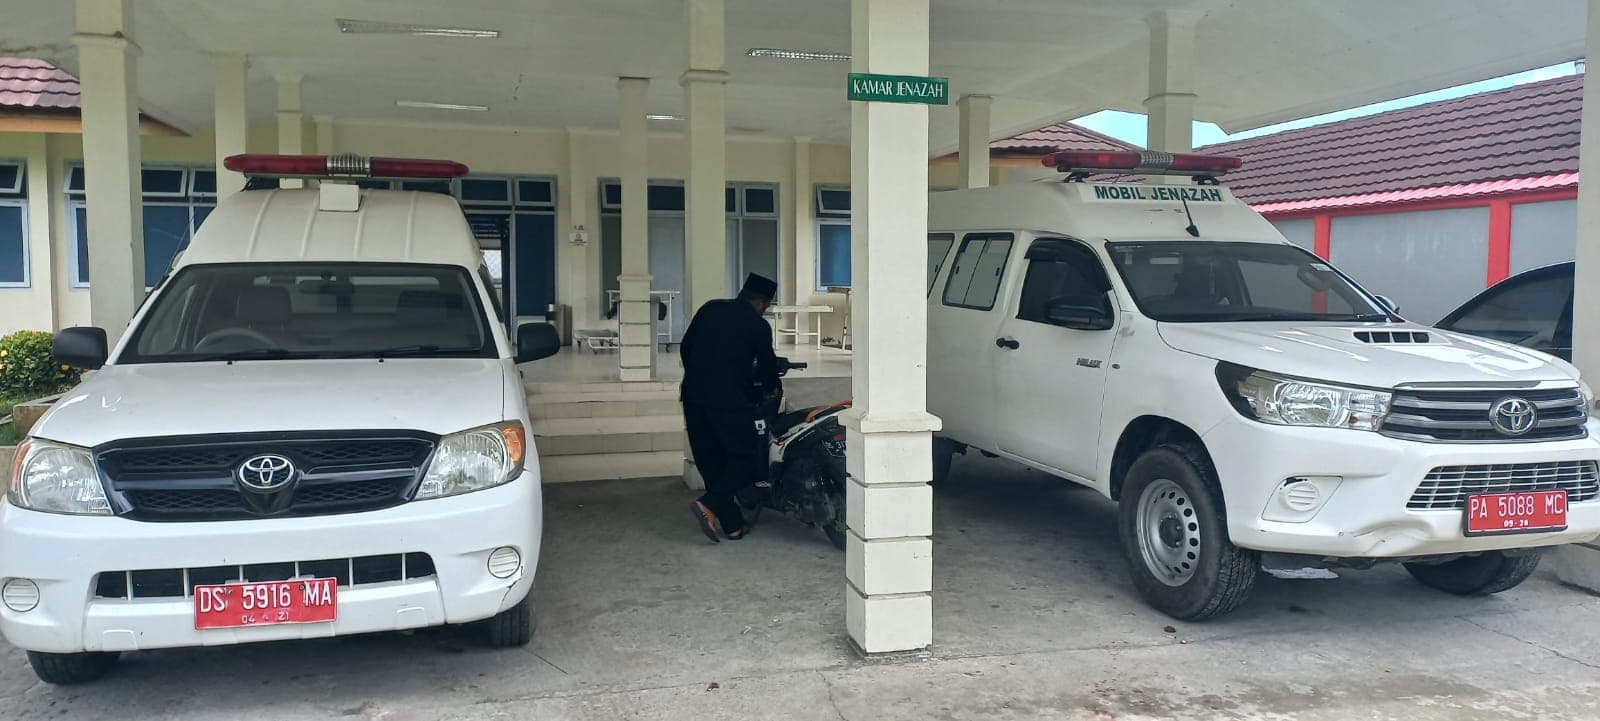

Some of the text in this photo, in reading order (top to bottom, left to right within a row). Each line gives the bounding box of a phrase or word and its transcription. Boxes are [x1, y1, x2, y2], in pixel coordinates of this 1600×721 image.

[853, 79, 943, 98] KAMAR JENAZAH
[1094, 185, 1222, 202] MOBIL JENAZAH
[1470, 493, 1564, 520] PA 5088 MC
[200, 580, 332, 613] DS 5916 MA
